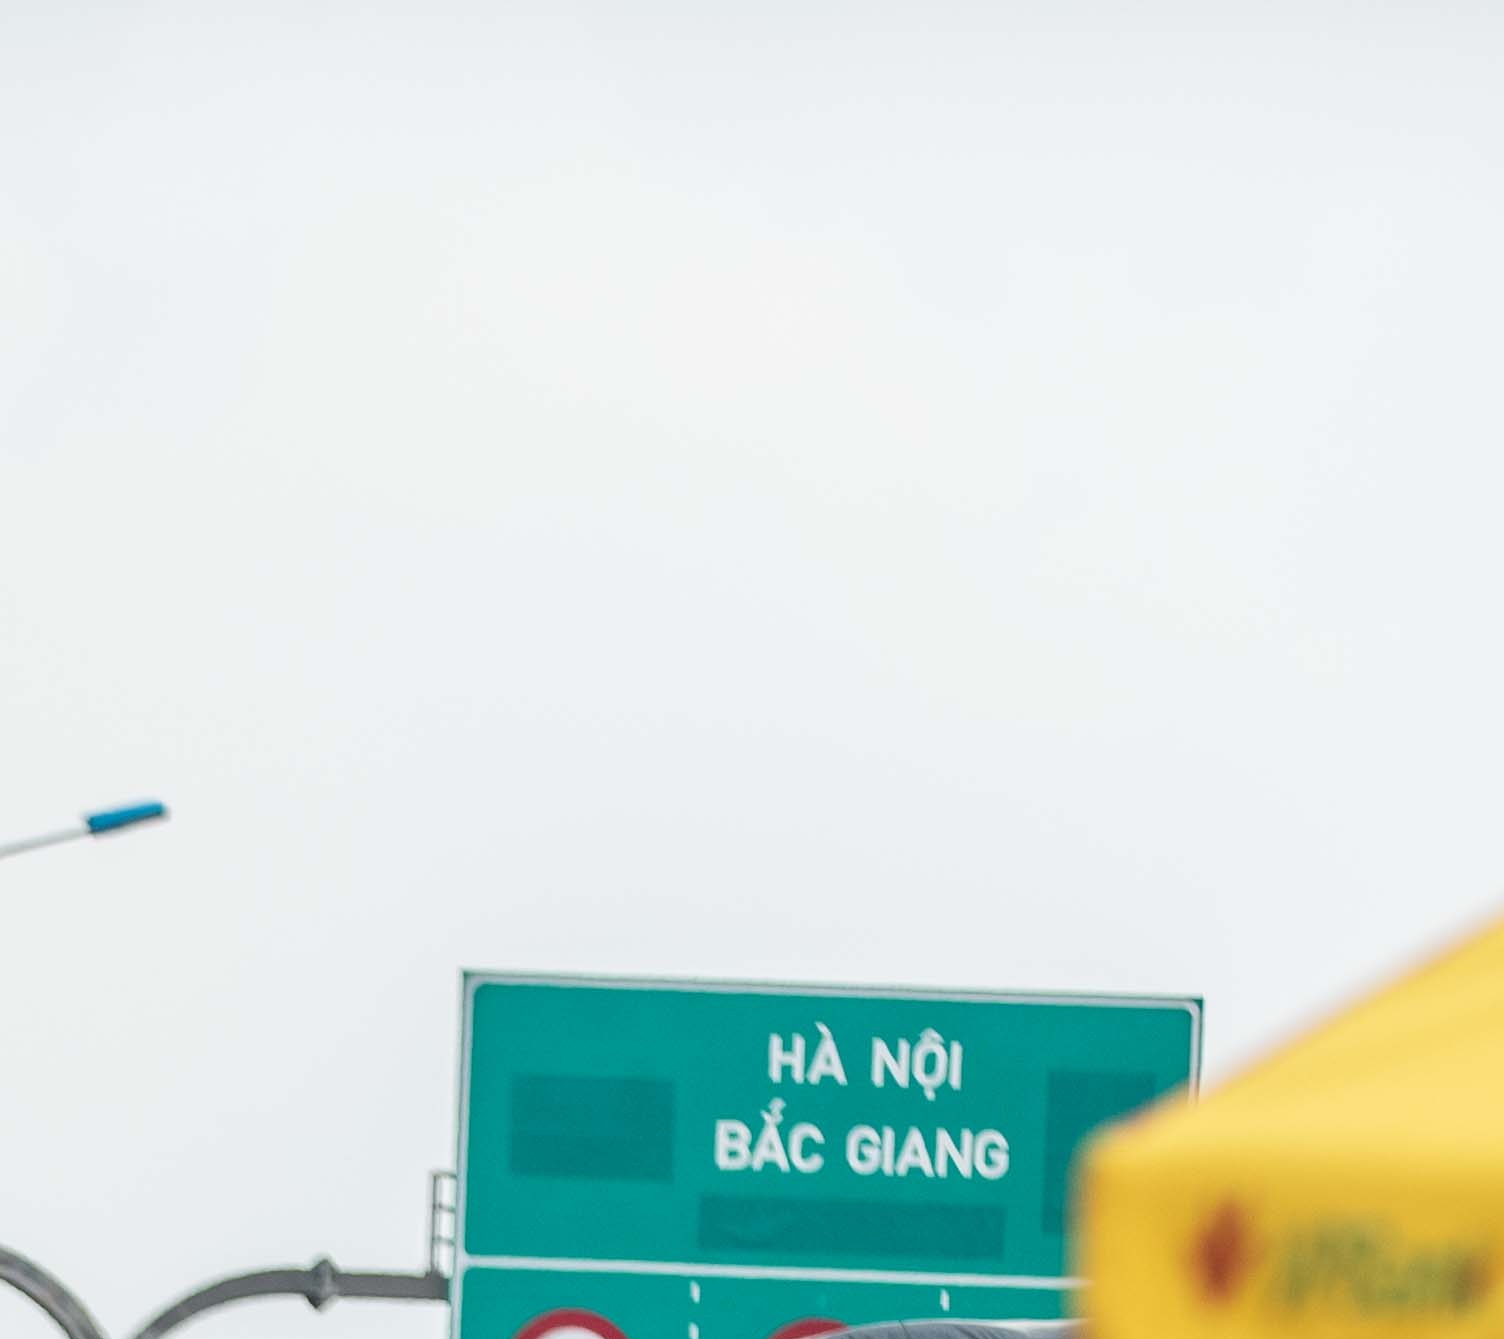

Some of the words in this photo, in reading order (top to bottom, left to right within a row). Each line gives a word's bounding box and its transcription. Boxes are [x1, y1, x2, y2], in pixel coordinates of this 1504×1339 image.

[768, 1021, 848, 1086] HÀ
[871, 1027, 963, 1101] NỘI
[845, 1124, 1010, 1180] GIANG
